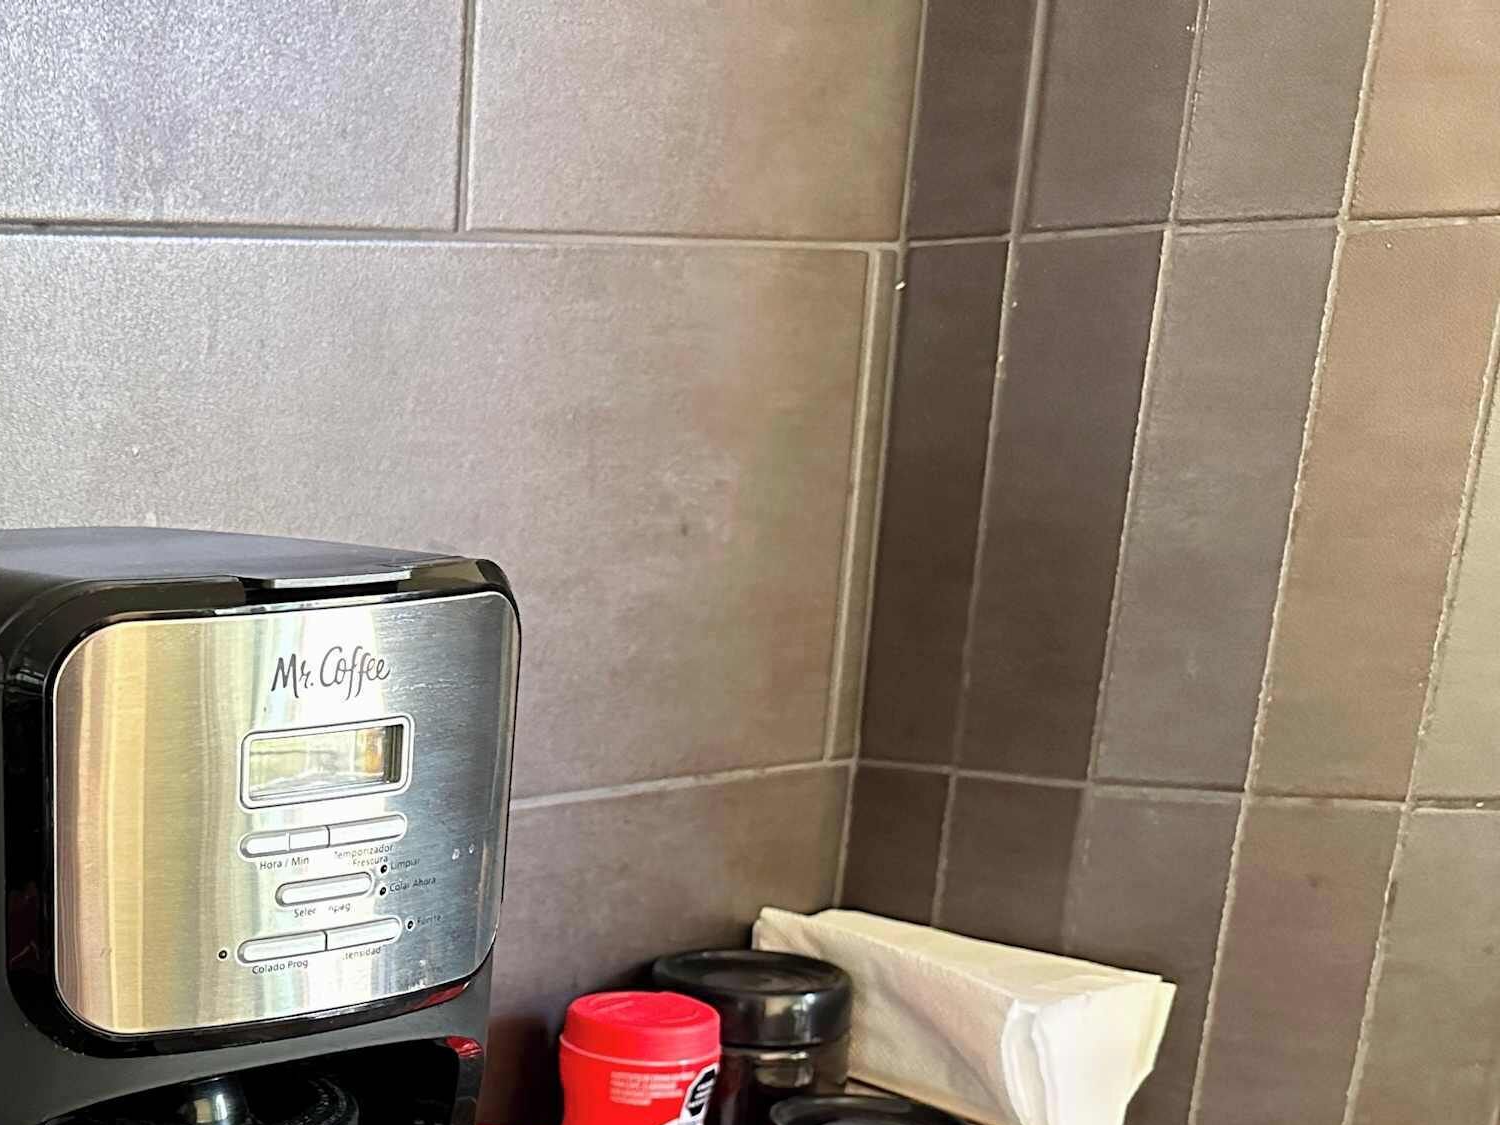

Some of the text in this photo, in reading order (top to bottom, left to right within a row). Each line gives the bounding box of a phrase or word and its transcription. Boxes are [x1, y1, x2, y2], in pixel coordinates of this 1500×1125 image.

[271, 646, 390, 701] Mr. Coffee
[334, 843, 393, 859] emporizador
[260, 860, 282, 870] Hora
[291, 856, 309, 866] Min
[413, 876, 437, 888] Ahora
[342, 945, 382, 960] tensidad
[252, 959, 309, 975] Colado Prog
